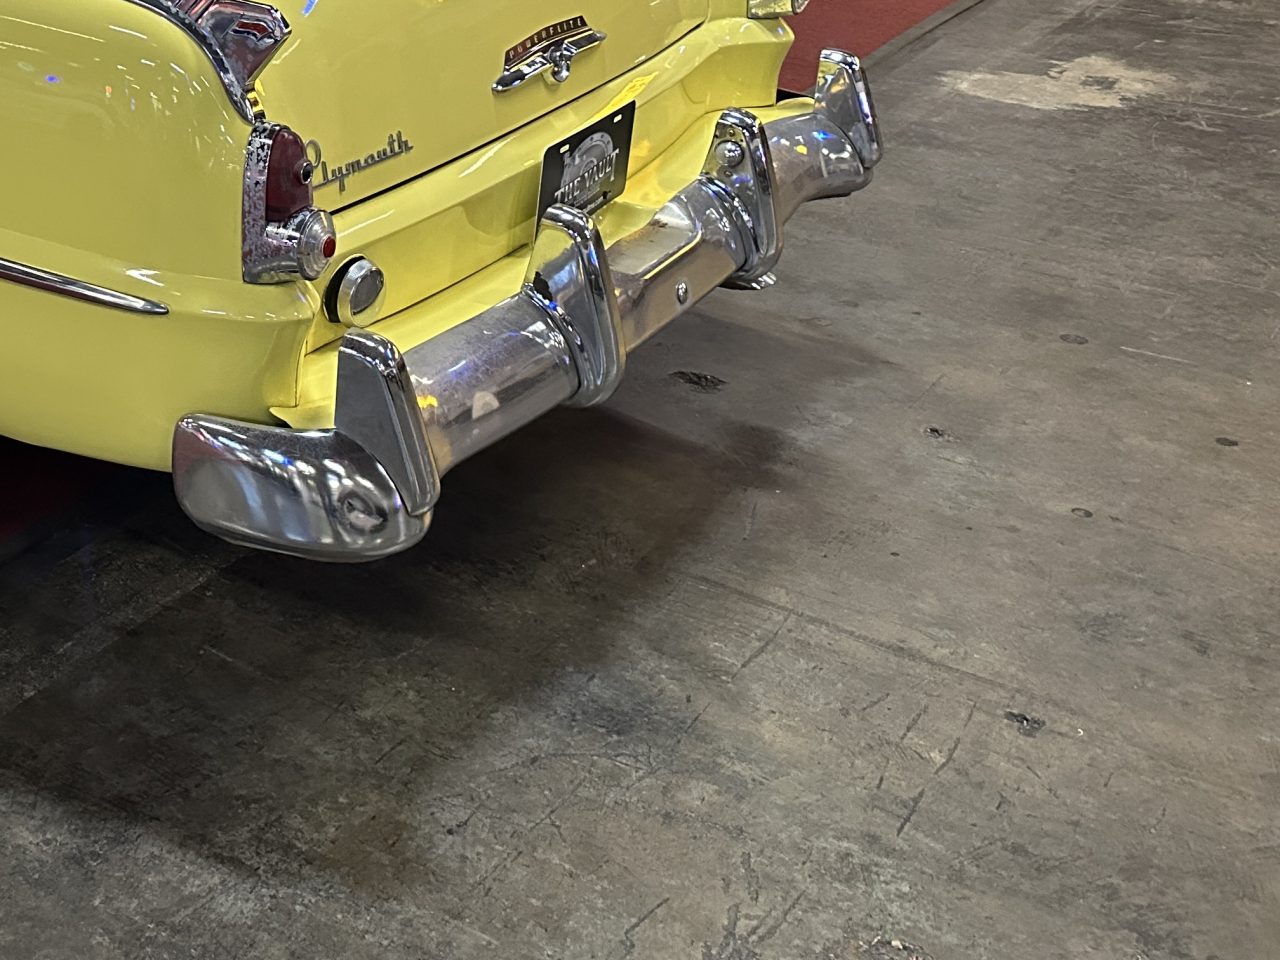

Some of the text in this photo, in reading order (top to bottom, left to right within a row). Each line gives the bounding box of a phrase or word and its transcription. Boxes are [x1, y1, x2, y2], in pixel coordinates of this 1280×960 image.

[508, 17, 583, 59] POWERFLITE
[304, 130, 414, 196] Plymouth
[554, 178, 582, 204] THE
[583, 147, 620, 189] VAULT
